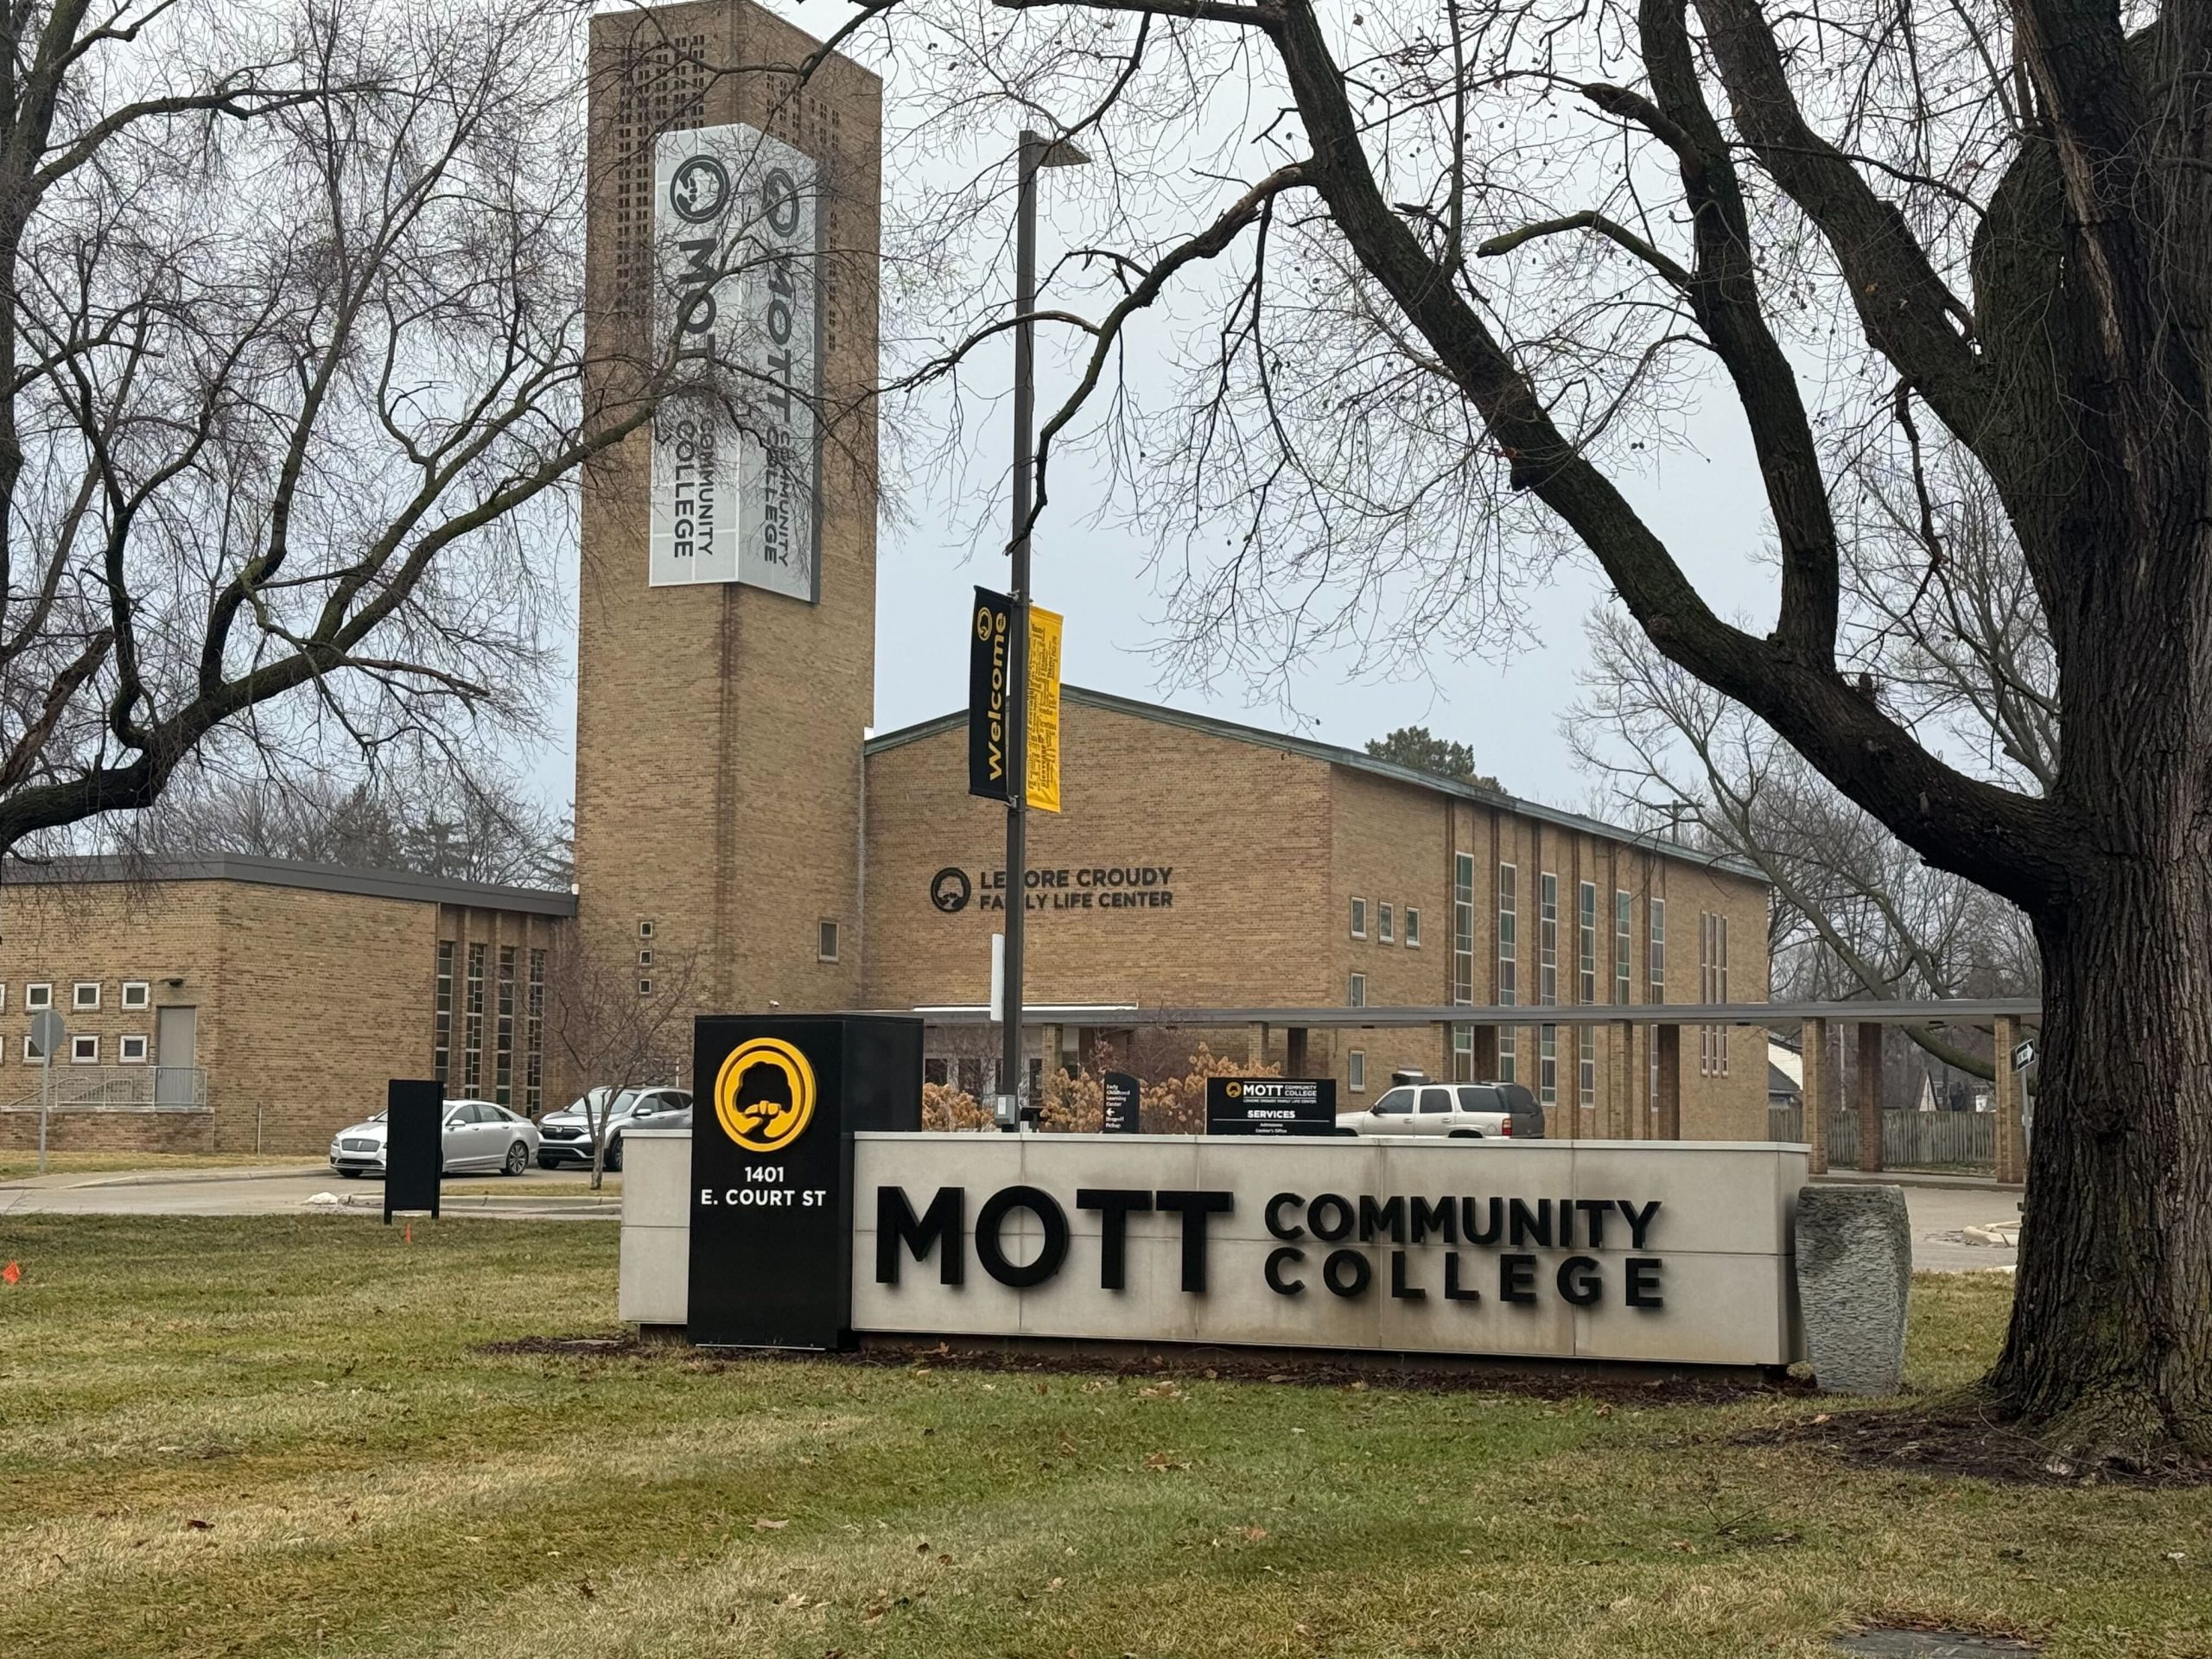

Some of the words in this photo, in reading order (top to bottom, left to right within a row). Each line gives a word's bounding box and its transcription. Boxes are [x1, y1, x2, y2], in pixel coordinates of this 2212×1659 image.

[674, 420, 695, 558] COLLEGE
[988, 612, 1007, 781] Welcome
[981, 869, 1070, 889] LEORE
[1077, 867, 1173, 887] CROUDY
[980, 893, 1048, 910] FALY
[1053, 893, 1093, 908] LIFE
[1098, 891, 1173, 907] CENTER
[1243, 1084, 1283, 1096] MOTT
[1247, 1109, 1296, 1119] SERVICES
[744, 1166, 785, 1182] 1401
[701, 1189, 718, 1205] E.
[726, 1189, 795, 1205] COURT
[802, 1190, 826, 1206] ST
[1264, 1192, 1662, 1249] COMMUNITY
[875, 1185, 1235, 1293] MOTT
[1264, 1247, 1663, 1307] COLLEGE
